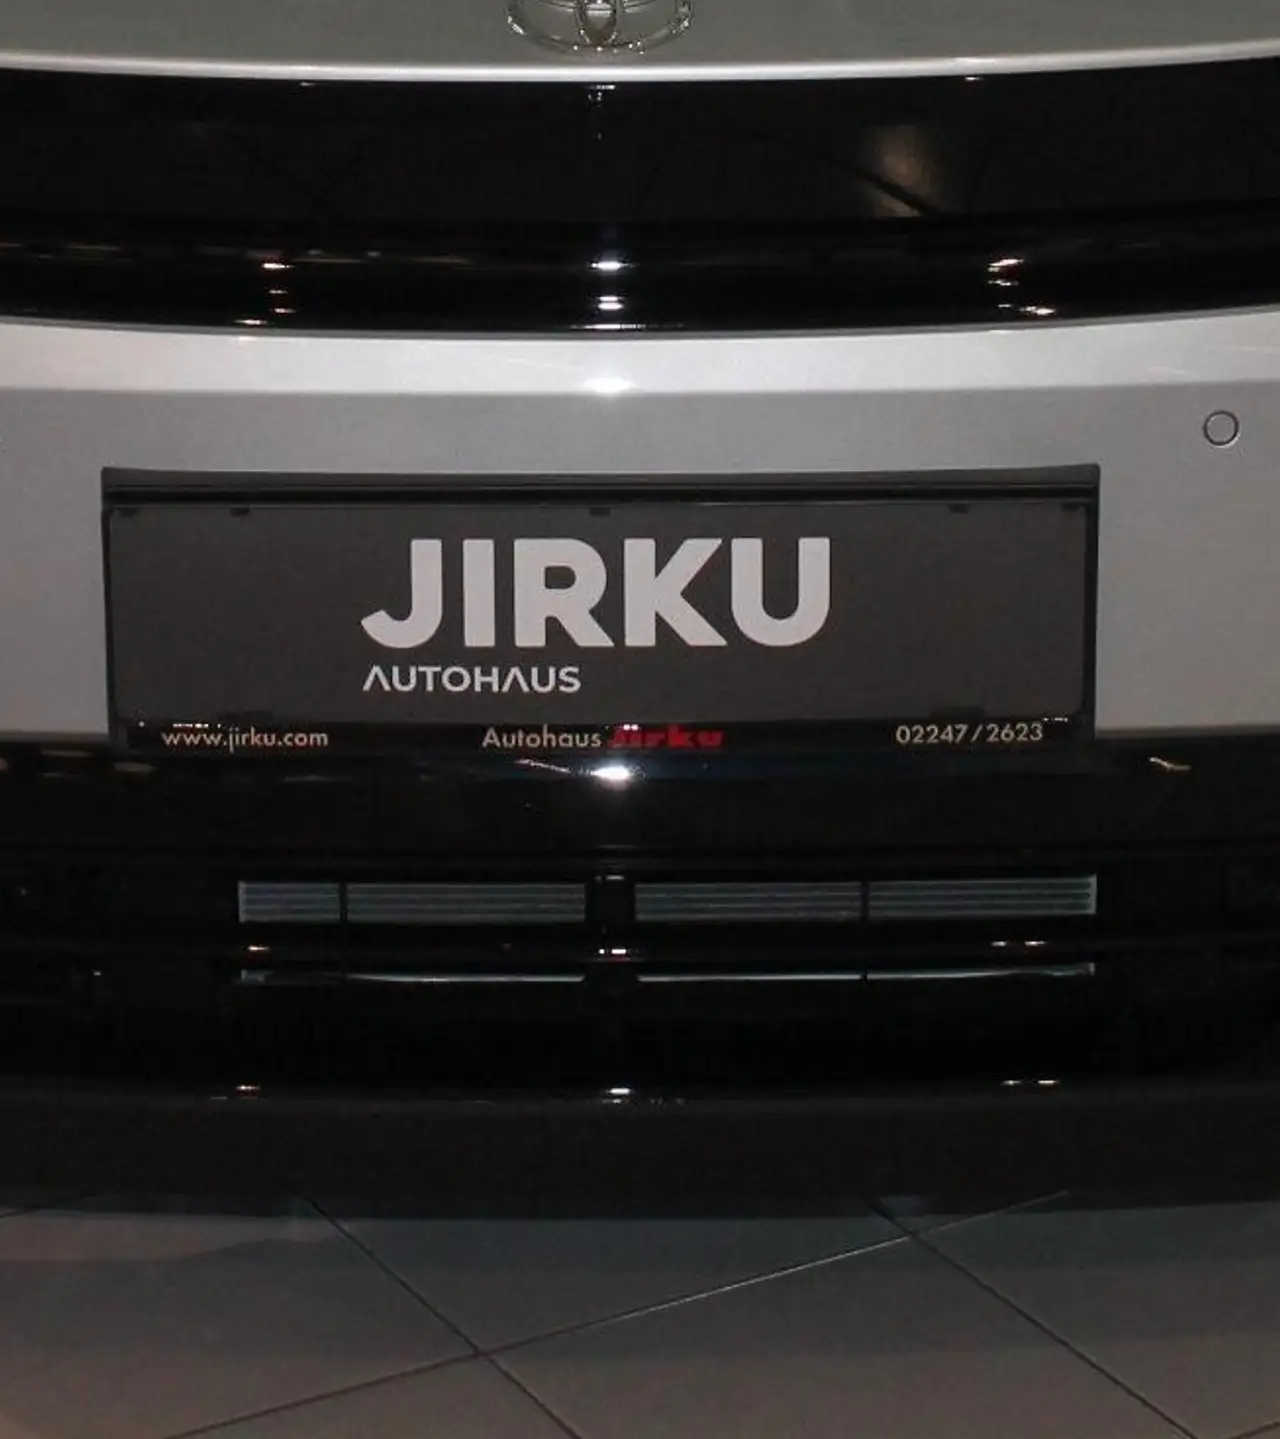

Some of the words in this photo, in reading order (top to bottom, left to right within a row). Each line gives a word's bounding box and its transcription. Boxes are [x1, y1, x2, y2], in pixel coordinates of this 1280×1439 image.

[360, 536, 830, 649] JIRKU
[362, 664, 581, 693] AUTOHAUS
[161, 726, 329, 754] www.jirku.com
[481, 724, 602, 748] Autohaus
